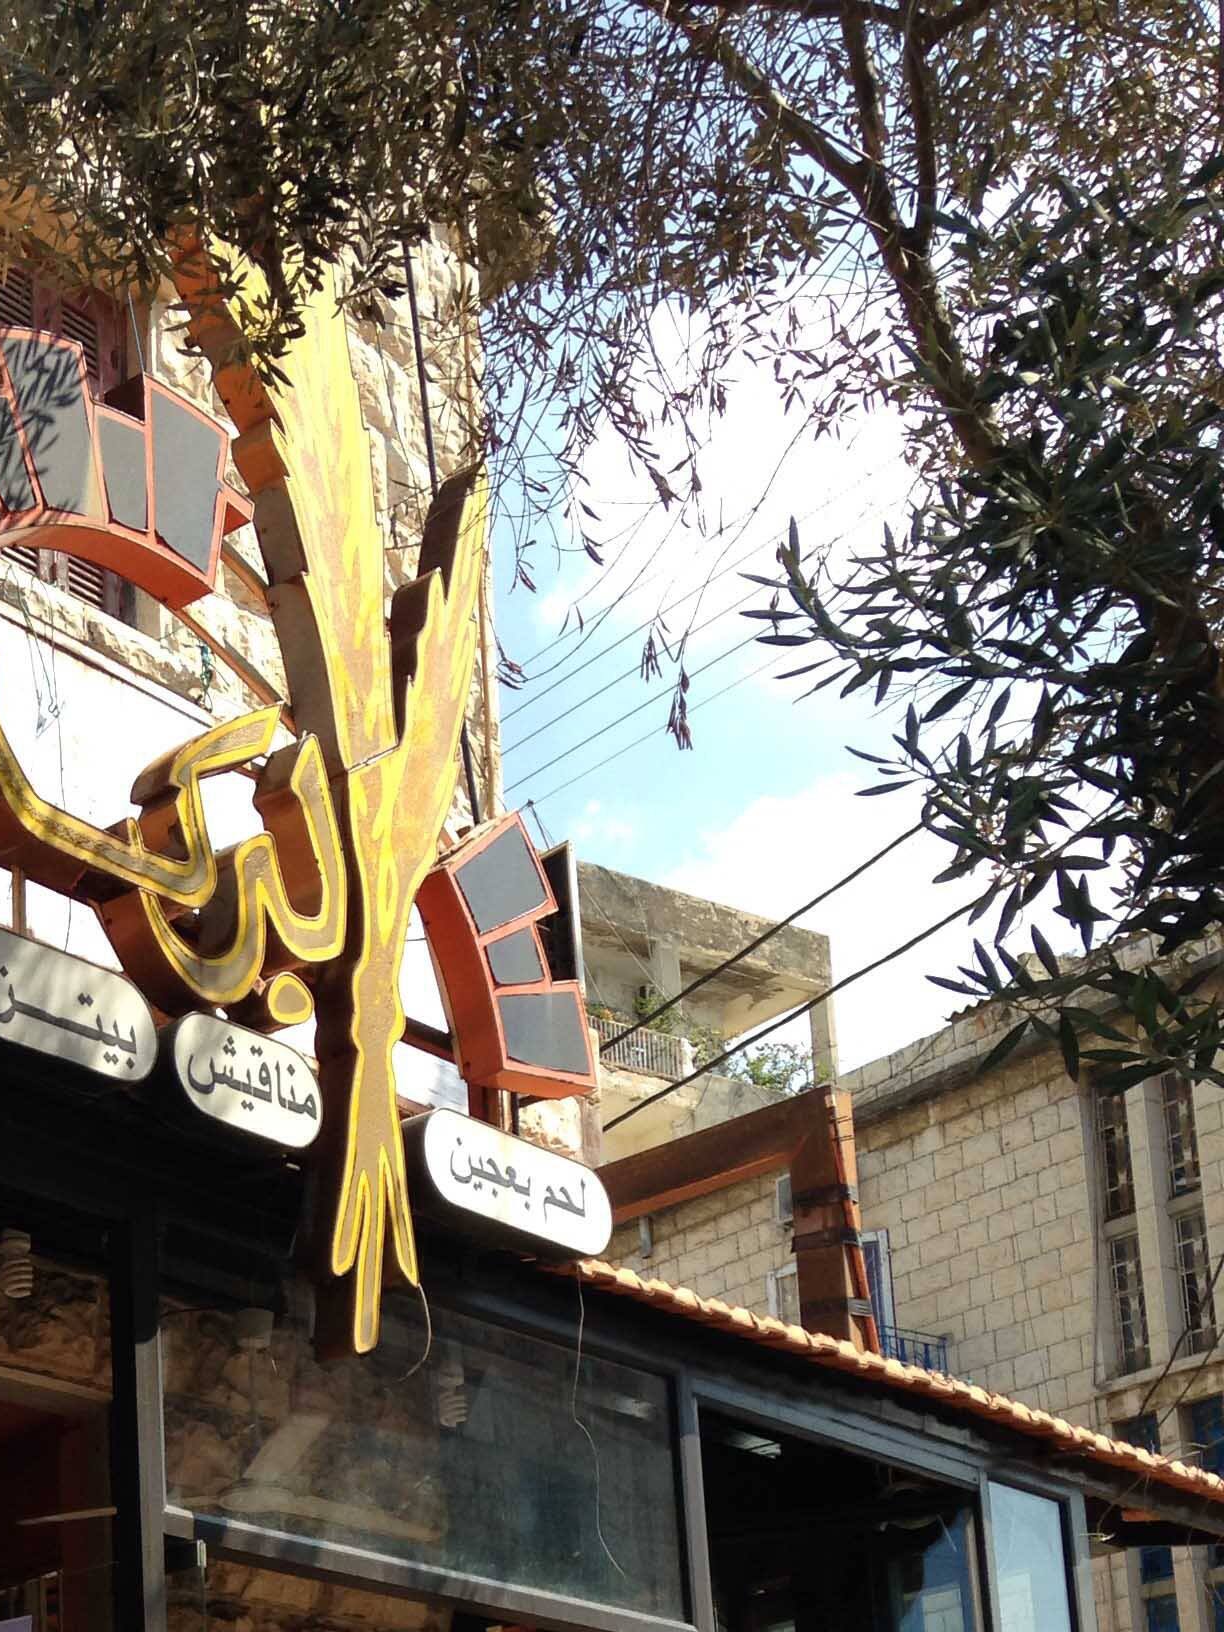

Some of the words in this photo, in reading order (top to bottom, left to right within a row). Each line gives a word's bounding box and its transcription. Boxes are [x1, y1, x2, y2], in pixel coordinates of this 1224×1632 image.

[188, 1036, 317, 1120] مناقيش
[449, 1137, 531, 1209] بعجين
[542, 1179, 586, 1223] لحم
